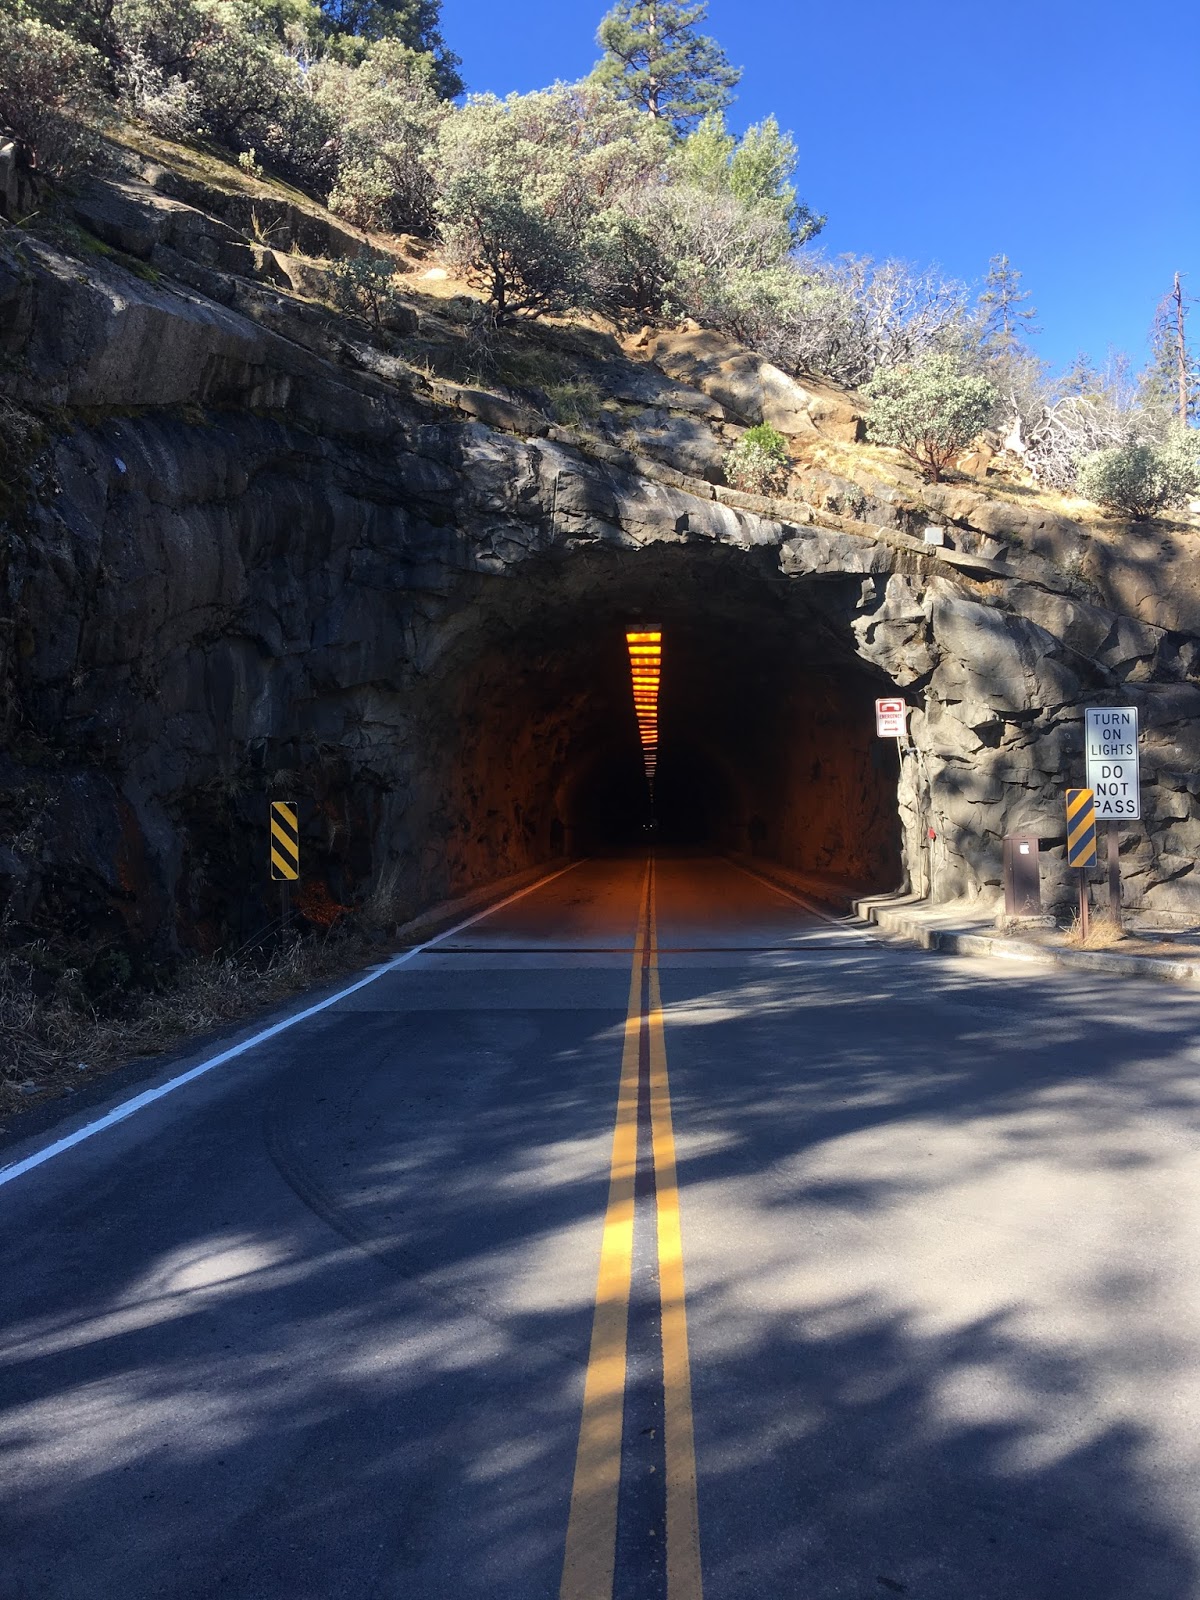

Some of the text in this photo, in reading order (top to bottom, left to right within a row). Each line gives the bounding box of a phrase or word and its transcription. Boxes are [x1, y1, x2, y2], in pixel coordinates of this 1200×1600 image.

[1093, 713, 1130, 725] TURN
[1102, 728, 1122, 740] ON
[1091, 743, 1133, 756] LIGHTS
[1102, 765, 1123, 778] DO
[1097, 783, 1129, 796] NOT
